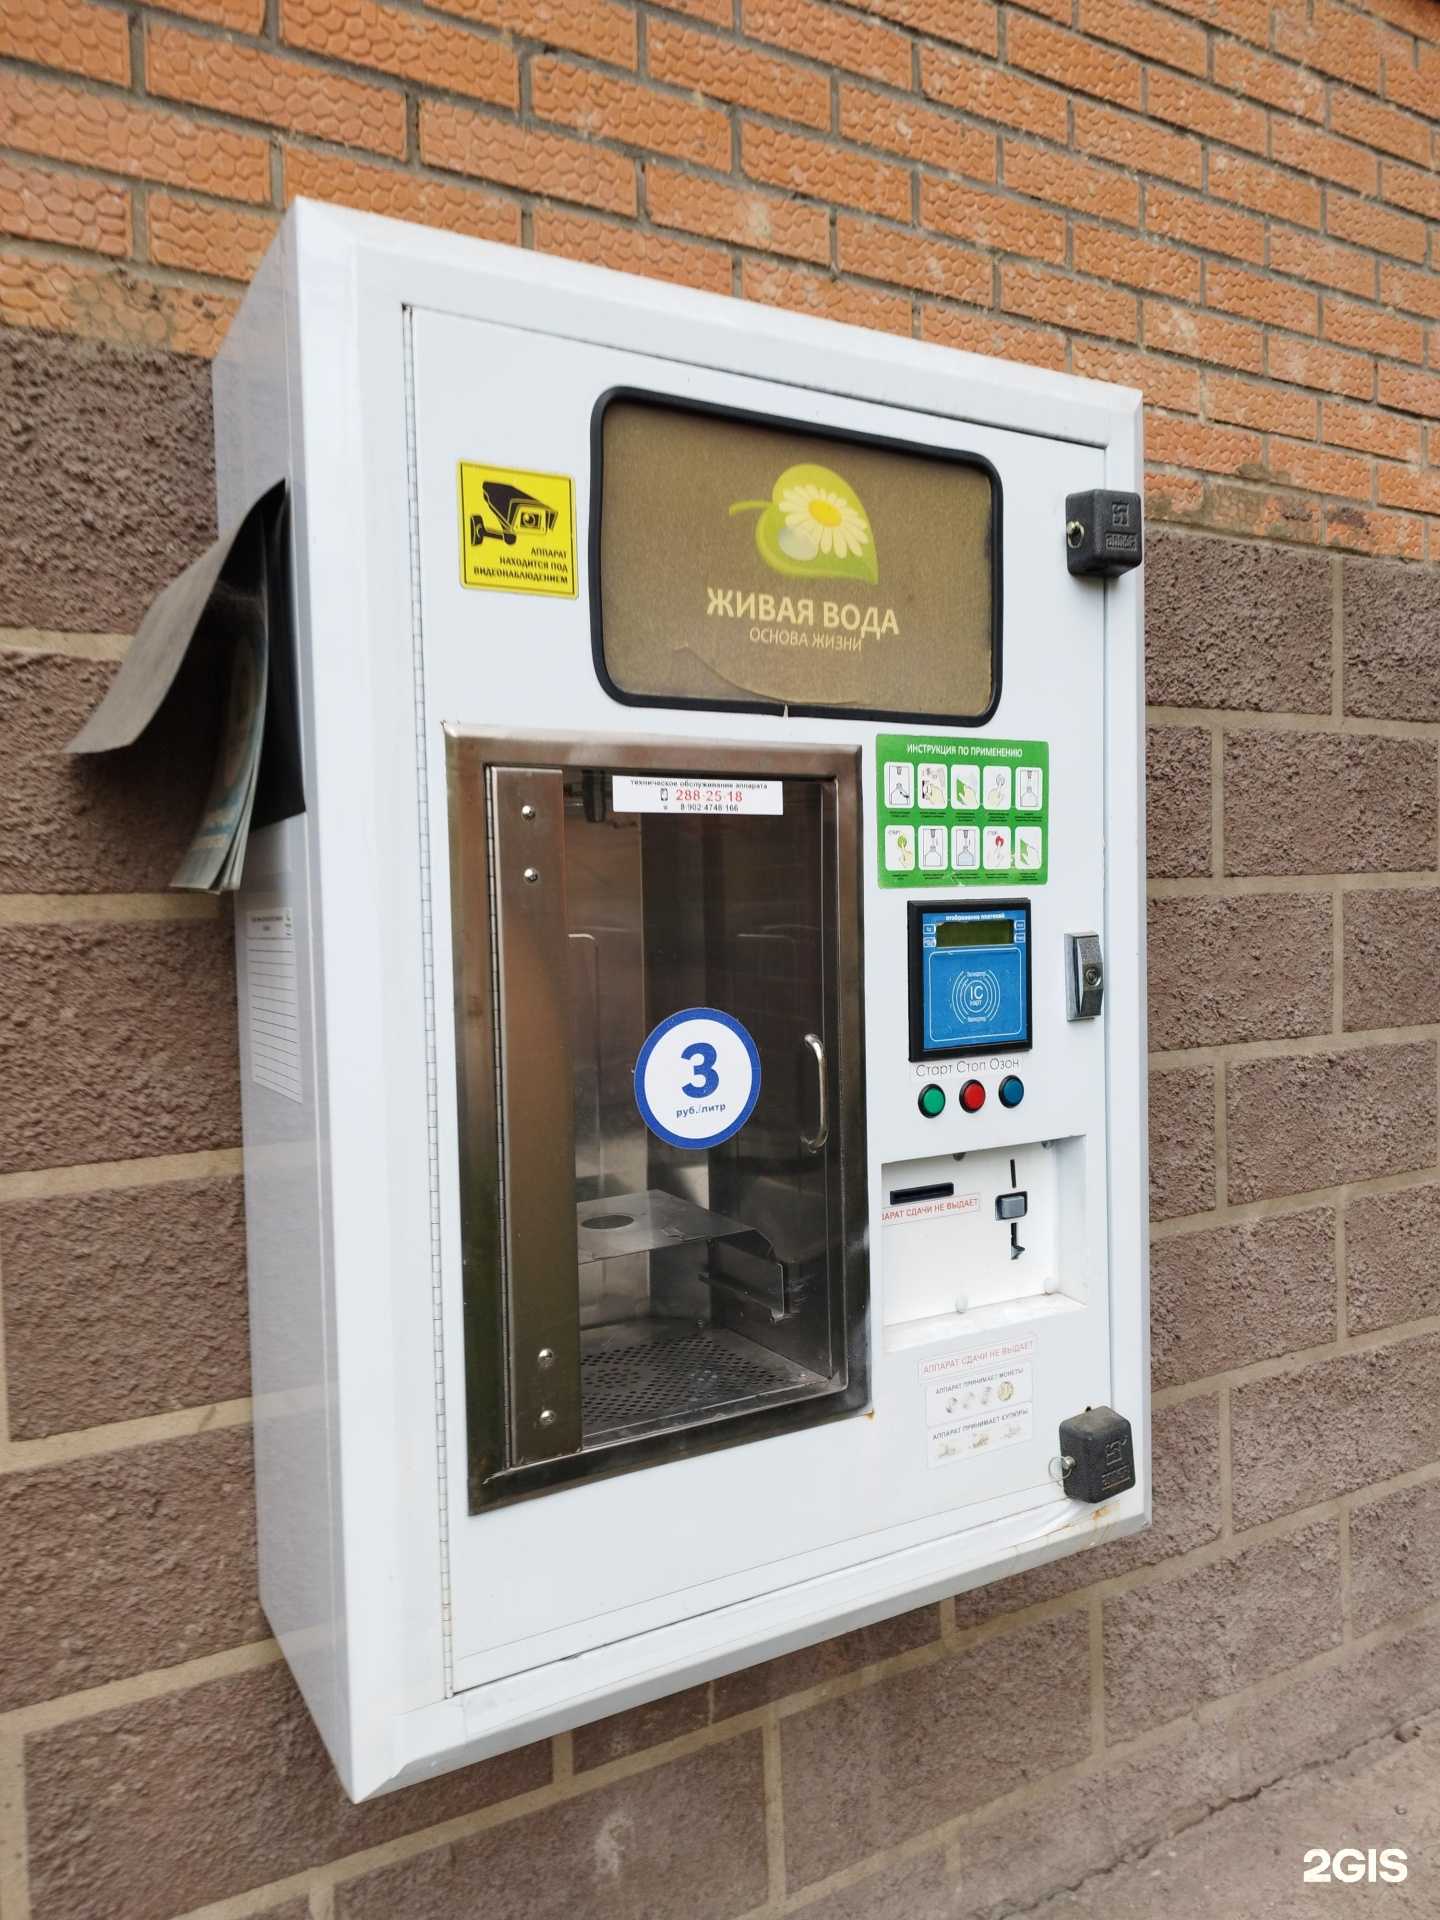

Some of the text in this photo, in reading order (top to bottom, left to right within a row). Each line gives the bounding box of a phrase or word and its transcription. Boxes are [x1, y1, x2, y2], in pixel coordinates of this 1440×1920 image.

[499, 556, 568, 573] НАХОДИТСЯ ПОД
[531, 547, 567, 559] АППАРАТ
[473, 566, 568, 585] ВИДЕОНАБЛЮДЕНИЕМ
[706, 587, 899, 640] ЖИВАЯ ВОДА
[749, 627, 862, 653] ОСНОВА ЖИЗНИ
[906, 743, 1023, 758] ИНСТРУКЦИЯ ПО ПРИМЕНЕНИЮ
[970, 985, 983, 1000] IC
[681, 1042, 719, 1098] 3
[916, 1057, 1020, 1078] Старт Стоп Озон
[881, 1198, 978, 1222] АРАТ СДАЧИ НЕ ВЫДАЕТ
[923, 1358, 960, 1374] АППАРАТ
[961, 1351, 988, 1366] СДАЧИ
[989, 1349, 1000, 1359] НЕ
[935, 1367, 1024, 1394] АППАРАТ ПРИНИМАЕТ МОНЕТЫ
[932, 1426, 961, 1440] АППАРАТ
[962, 1415, 1000, 1432] ПРИНИМАЕТ
